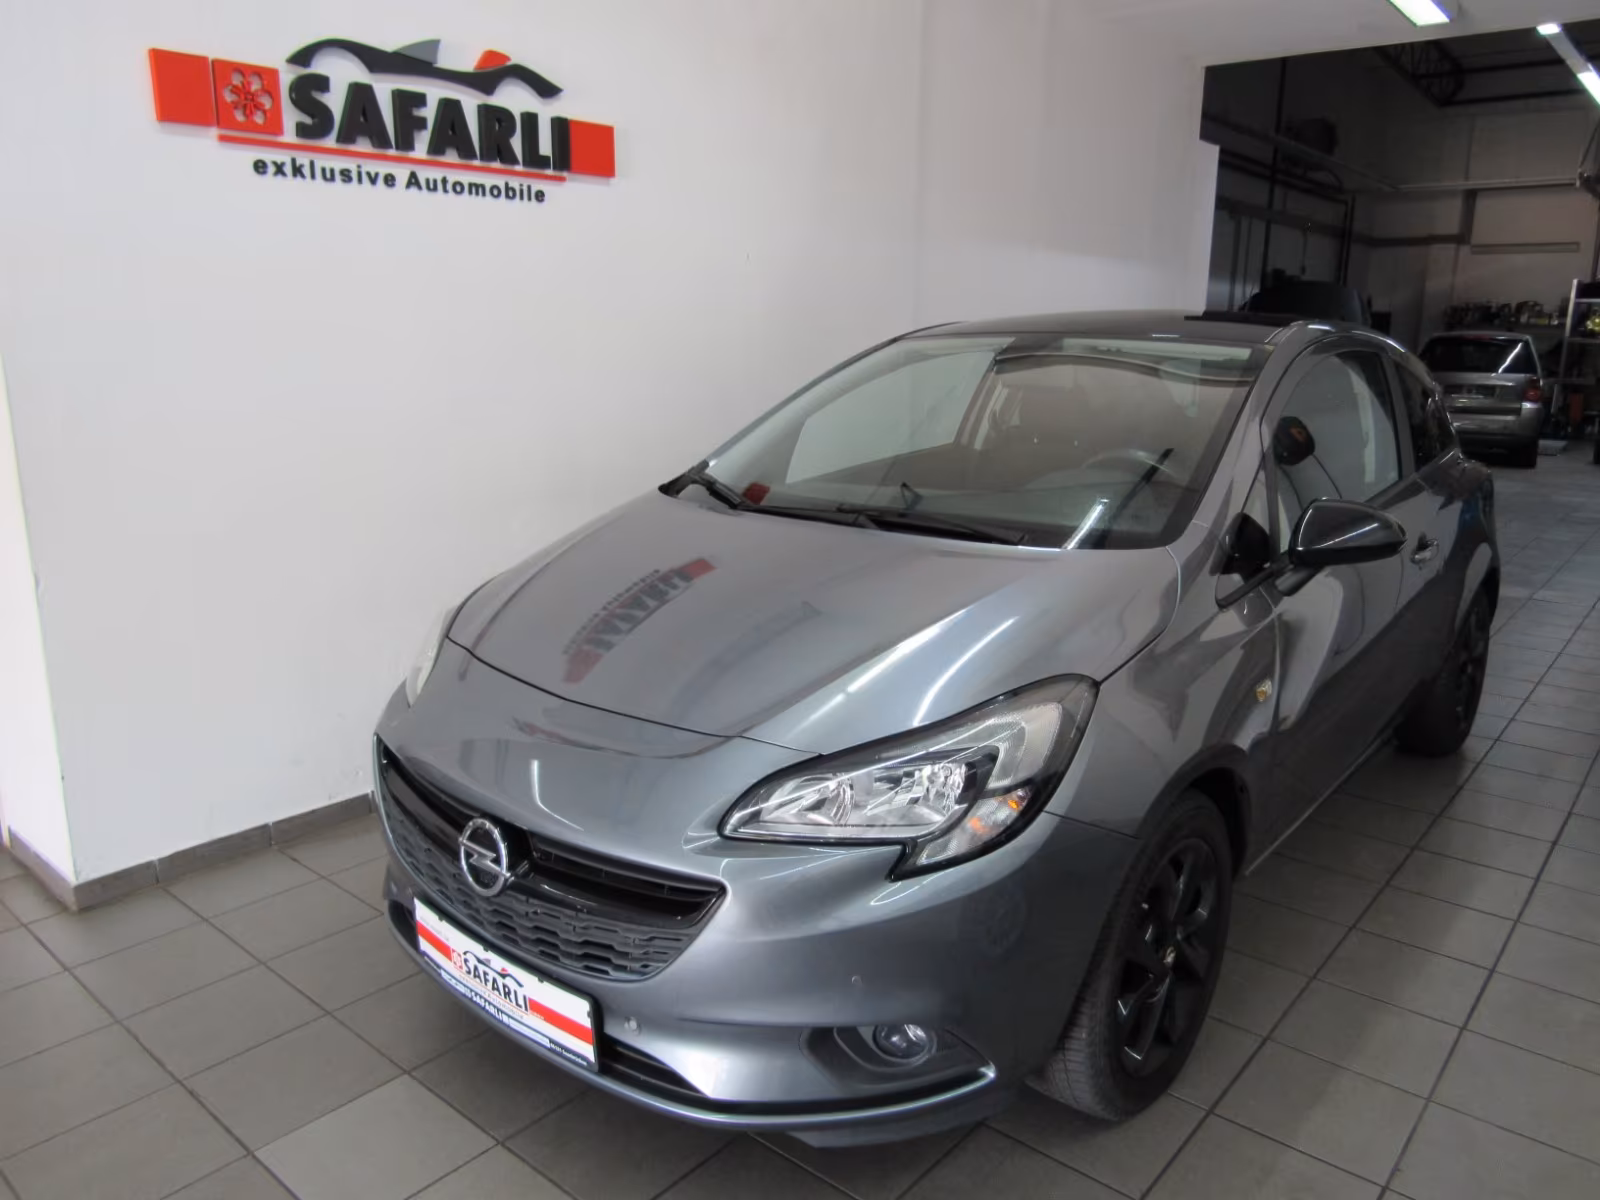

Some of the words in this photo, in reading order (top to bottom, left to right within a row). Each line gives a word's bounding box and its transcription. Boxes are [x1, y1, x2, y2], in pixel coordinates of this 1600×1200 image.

[288, 72, 571, 171] SAFARLI
[253, 157, 396, 188] exklusive
[405, 170, 545, 203] Automobile
[463, 957, 529, 1012] SAFARLI
